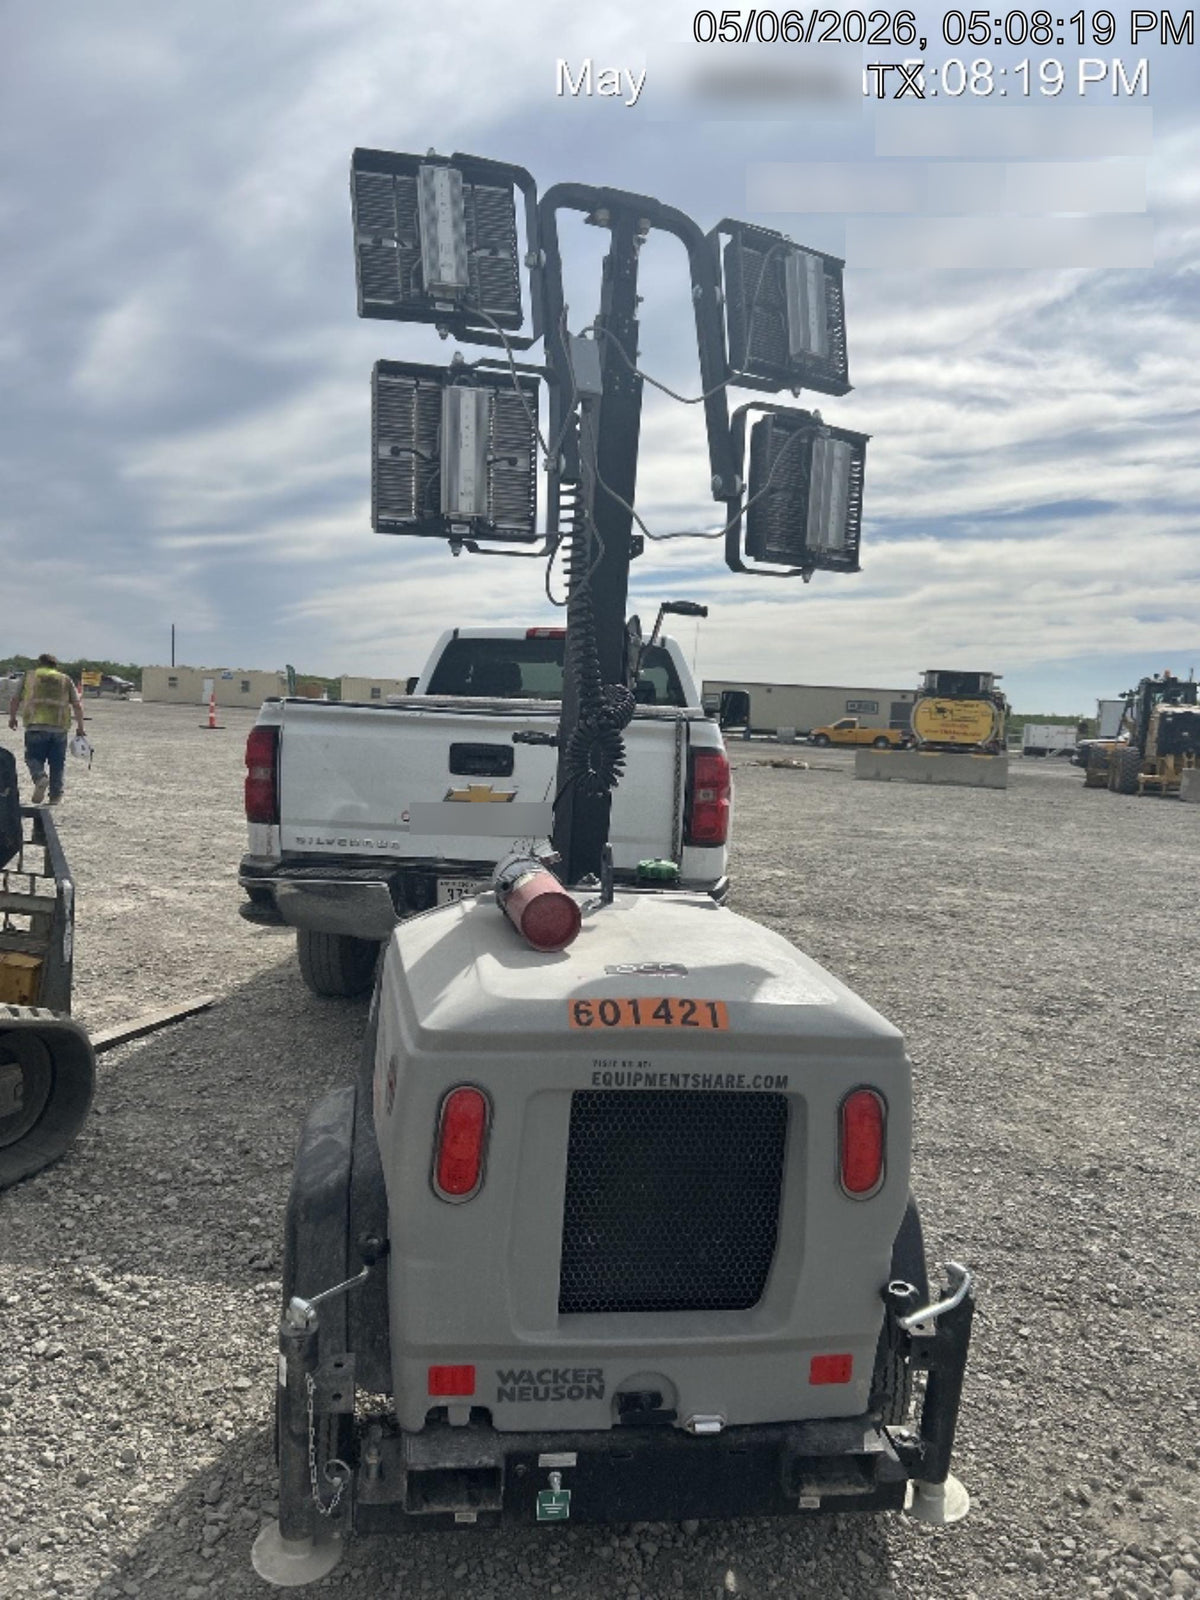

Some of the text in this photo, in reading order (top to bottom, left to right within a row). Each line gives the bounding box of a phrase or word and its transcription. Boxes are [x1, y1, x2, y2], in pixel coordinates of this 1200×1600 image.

[573, 998, 719, 1028] 601421
[592, 1071, 789, 1089] EQUIPMENTSHARE.COM
[496, 1368, 604, 1385] WACKER
[497, 1384, 605, 1402] NEUSON
